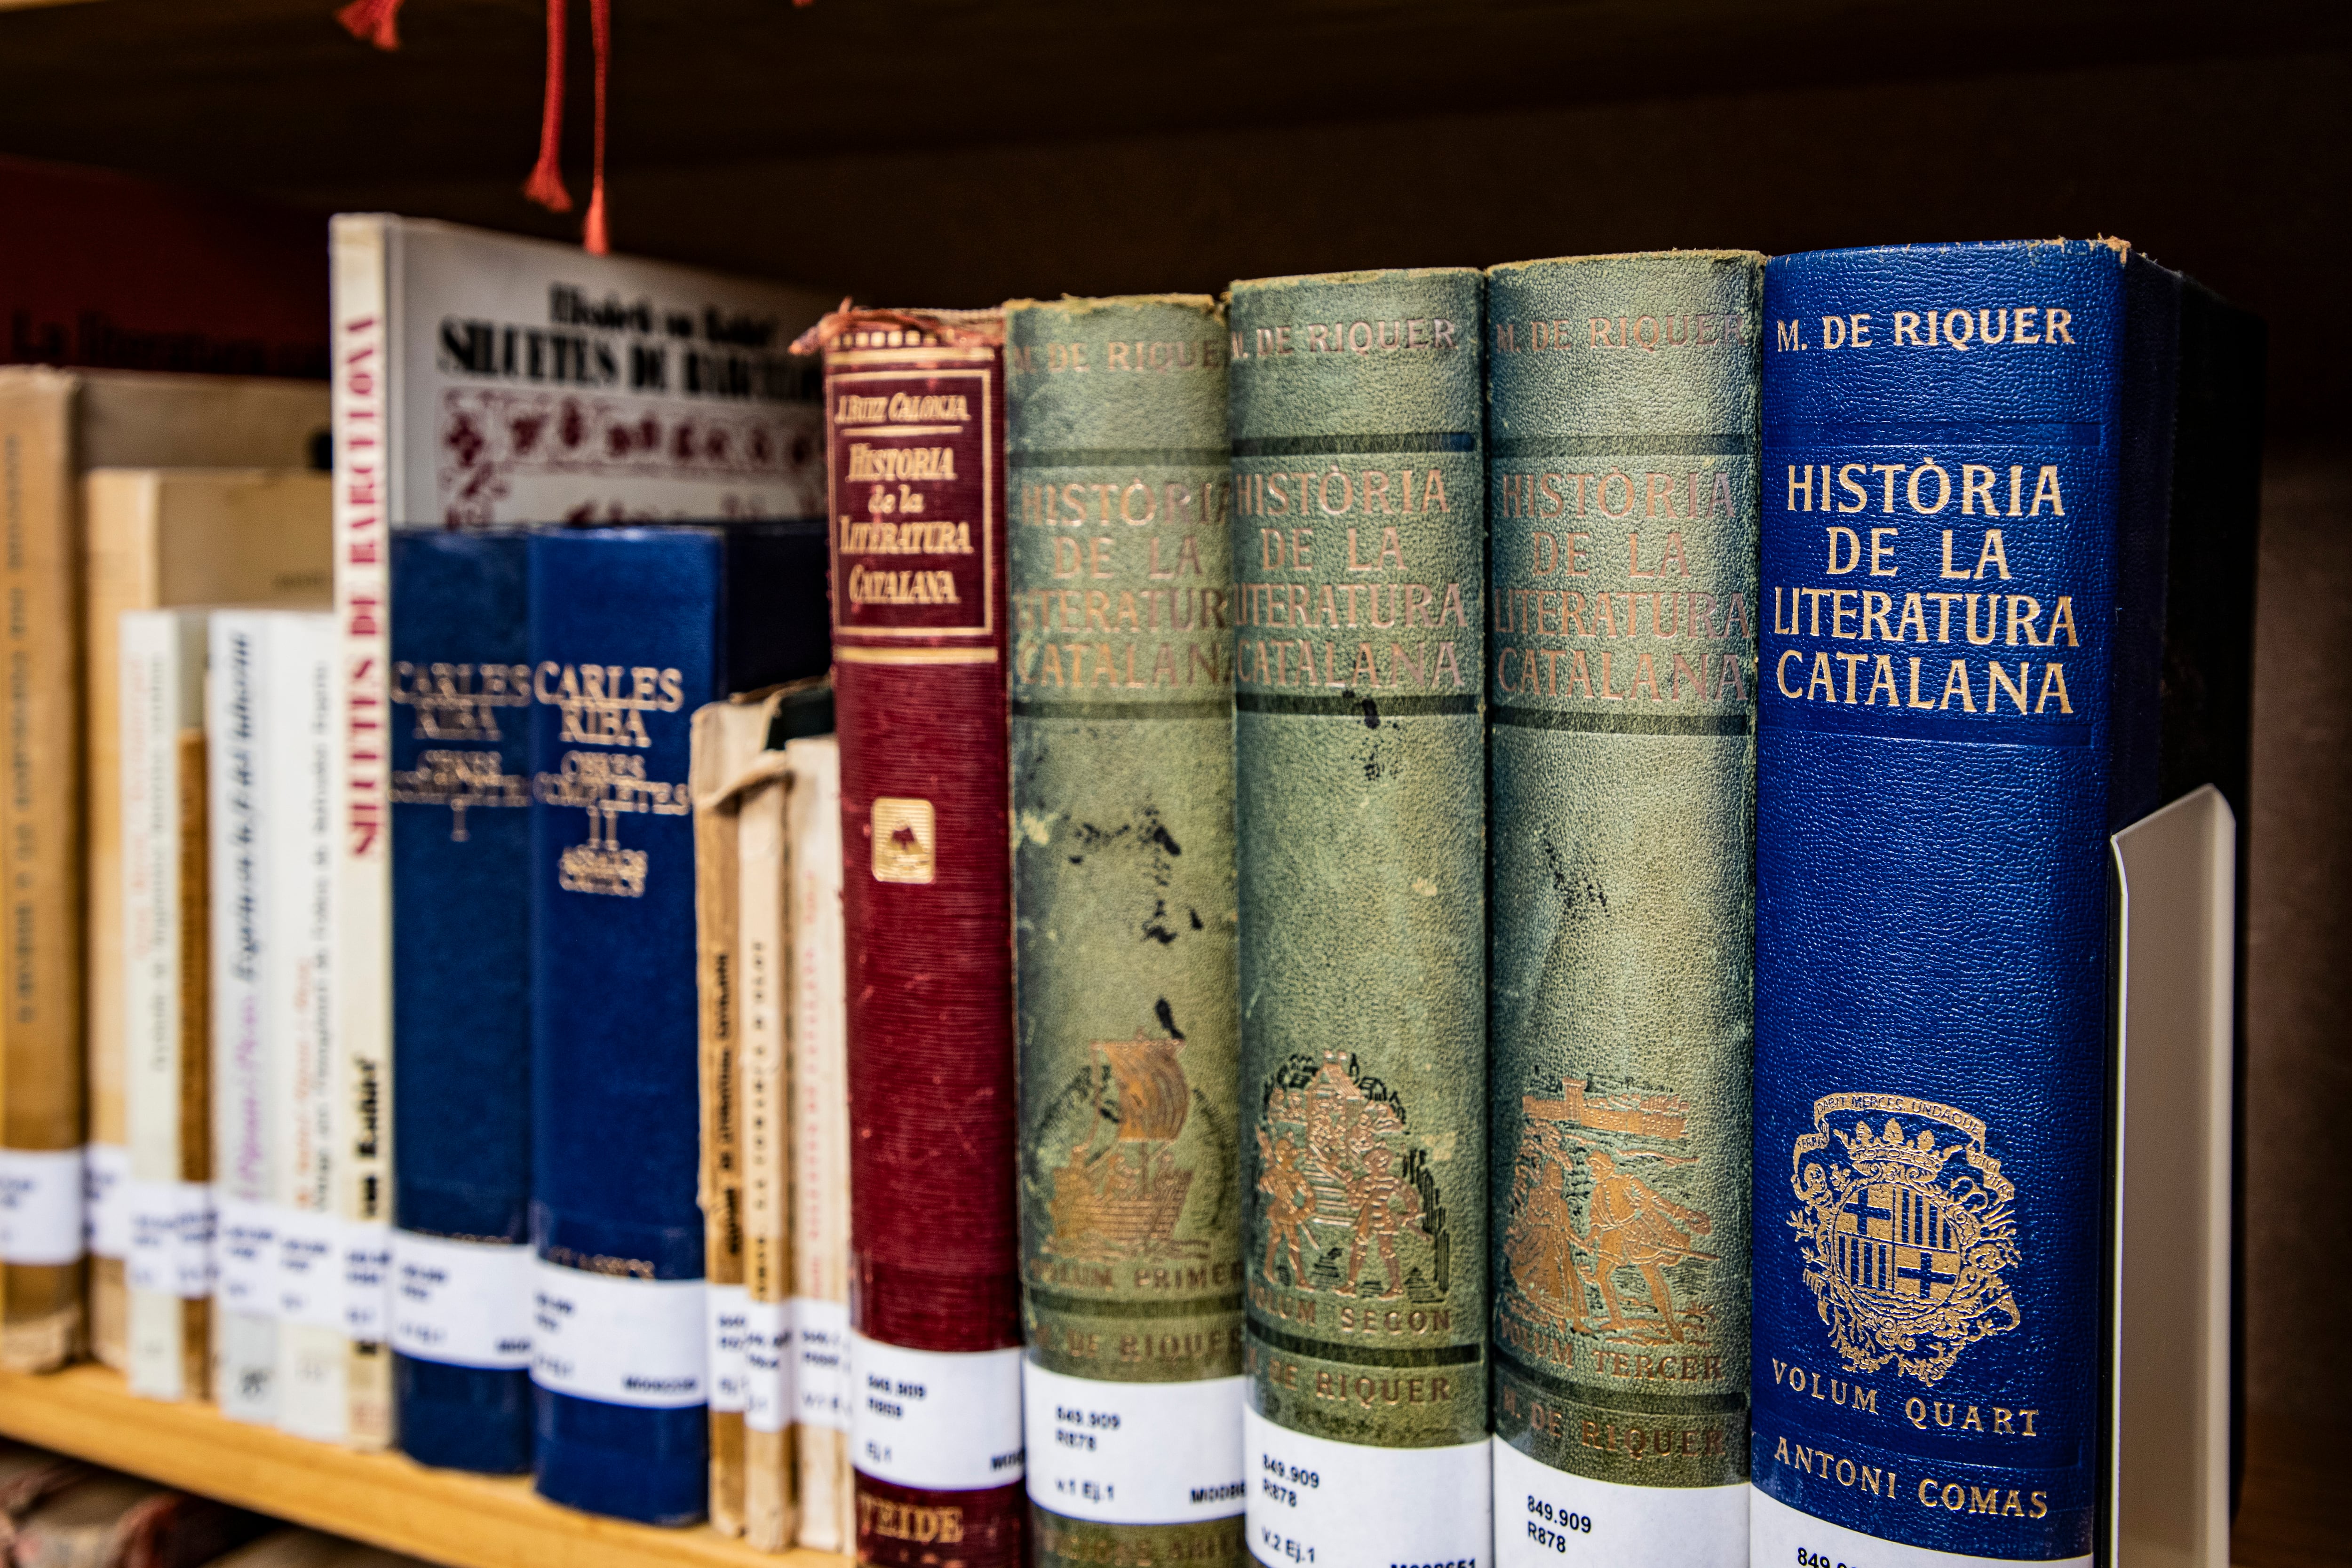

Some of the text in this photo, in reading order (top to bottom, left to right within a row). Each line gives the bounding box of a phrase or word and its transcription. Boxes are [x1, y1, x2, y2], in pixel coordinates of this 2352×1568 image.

[1256, 325, 1295, 356] DE
[1309, 317, 1458, 356] RIQUER
[1531, 318, 1572, 352] DE
[1588, 314, 1748, 354] RIQUER
[1778, 306, 2075, 353] M. DE RIQUER
[1048, 342, 1090, 373] DE
[1107, 340, 1230, 375] RIQUE
[845, 442, 958, 483] HISTORIA
[1787, 456, 2066, 517] HISTÒRIA
[867, 483, 924, 514] de la
[1236, 464, 1451, 516] HISTÒRIA
[1502, 465, 1736, 519] HISTÒRIA
[839, 515, 974, 554] LITERATURA
[1053, 535, 1203, 580] DE LA
[1260, 525, 1408, 572] DE LA
[1531, 531, 1691, 579] DE LA
[1826, 526, 2012, 580] DE LA
[848, 563, 962, 605] CATALANA
[1234, 582, 1468, 630] LITERATURA
[1494, 588, 1750, 640] LITERATURA
[1773, 586, 2080, 648] LITERATURA
[534, 660, 684, 713] CARLES
[1016, 641, 1232, 689] CATALAN
[1238, 638, 1466, 689] CATALANA
[1497, 646, 1749, 702] CATALANA
[1777, 649, 2074, 715] CATALANA
[1340, 1307, 1454, 1336] SEGON
[1499, 1314, 1726, 1383] VOLUM TERCER
[1269, 1357, 1298, 1392] DE
[1316, 1370, 1451, 1410] RIQUER
[1771, 1357, 2041, 1438] VOLUM QUART
[1531, 1401, 1563, 1438] DE
[1581, 1419, 1726, 1461] RIQUER
[1263, 1454, 1319, 1489] 849.909
[1263, 1477, 1297, 1507] R878
[1774, 1435, 2049, 1520] ANTONI COMAS
[1527, 1495, 1592, 1534] 849.909
[1527, 1520, 1567, 1553] R878
[1286, 1539, 1316, 1564] Ej.1
